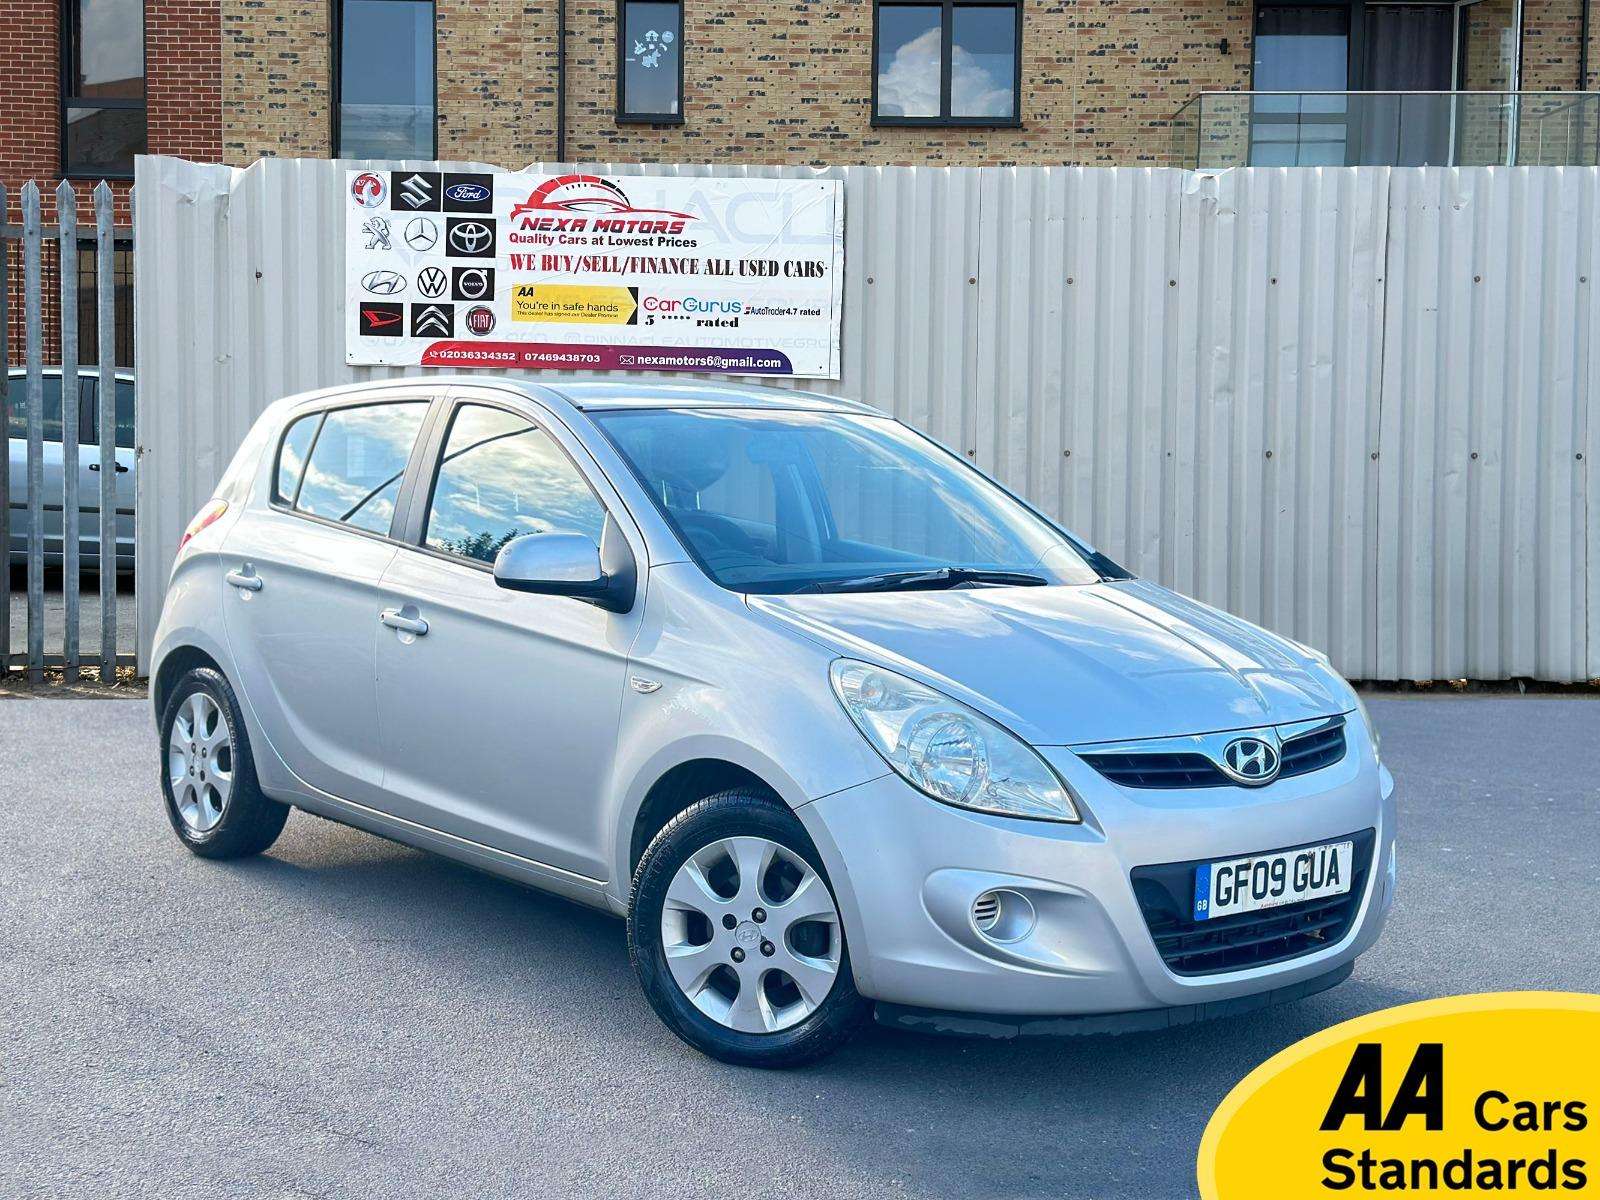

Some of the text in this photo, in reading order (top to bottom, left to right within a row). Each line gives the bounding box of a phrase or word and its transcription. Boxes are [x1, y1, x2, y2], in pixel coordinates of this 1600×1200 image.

[453, 186, 481, 200] Ford
[520, 217, 685, 234] NEXA MOTORS
[509, 233, 697, 248] Quality Cars at Lowest Prices
[509, 253, 536, 271] WE
[704, 258, 734, 276] ALL
[739, 259, 779, 277] USED
[784, 260, 825, 278] CARS
[517, 287, 534, 297] AA
[517, 301, 619, 312] You're in safe hands
[643, 296, 744, 313] CarGurus
[473, 314, 490, 328] FIAT
[644, 315, 739, 328] 5 rated
[439, 350, 601, 363] 02036334352 07469438703
[637, 355, 781, 369] nexamotors6@gmail.com
[1215, 847, 1340, 907] GF09 GUA
[1197, 899, 1208, 912] GB
